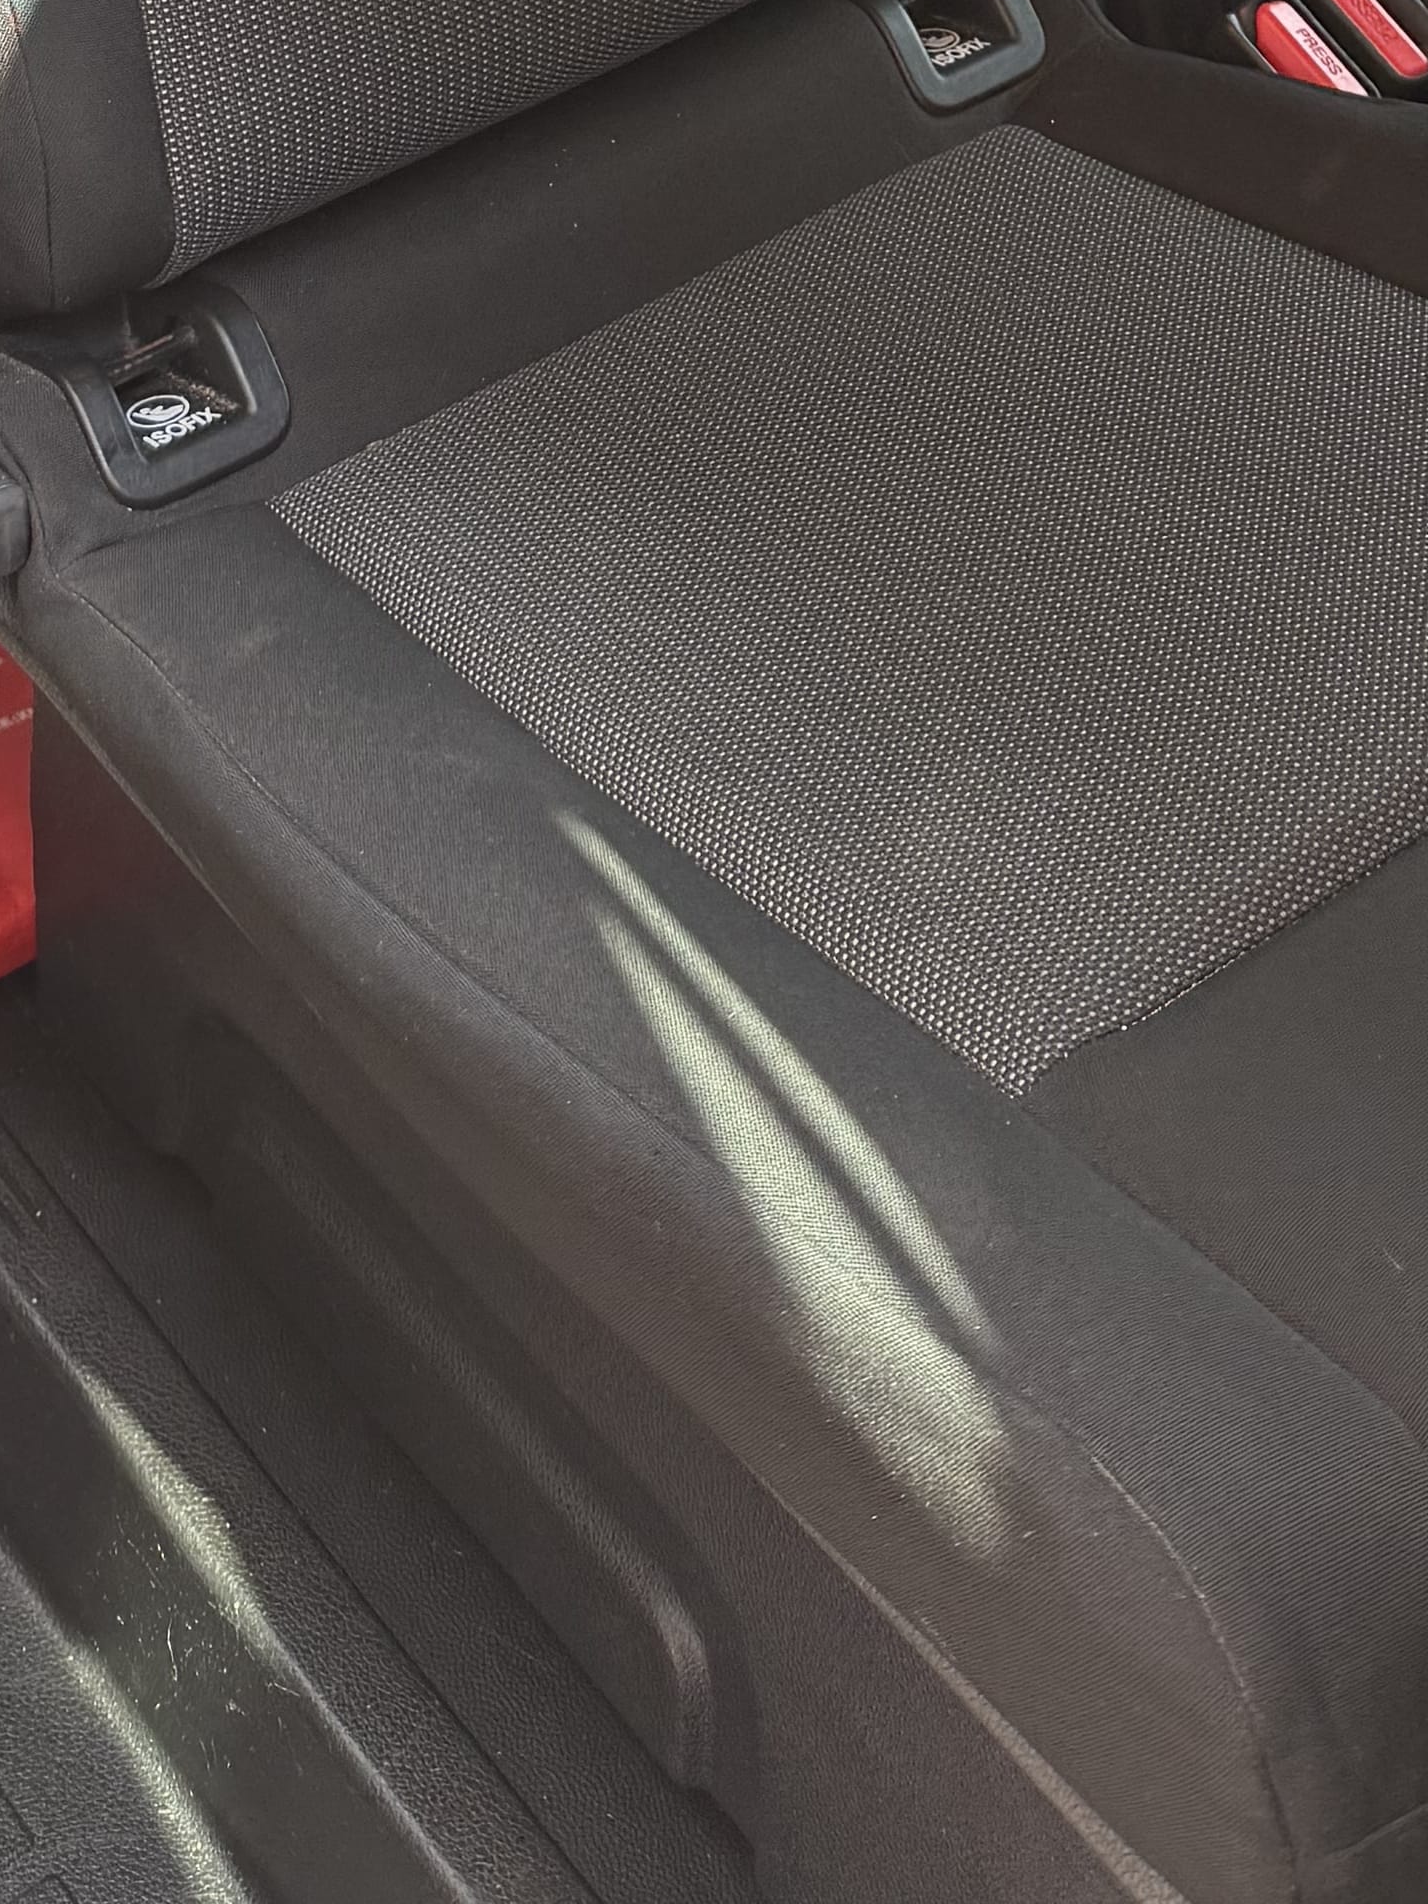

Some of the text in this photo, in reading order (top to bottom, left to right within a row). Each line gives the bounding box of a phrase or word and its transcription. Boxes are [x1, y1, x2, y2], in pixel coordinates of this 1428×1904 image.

[931, 37, 991, 67] ISOFIX
[1295, 28, 1343, 76] PRESS
[142, 406, 222, 448] ISOFIX
